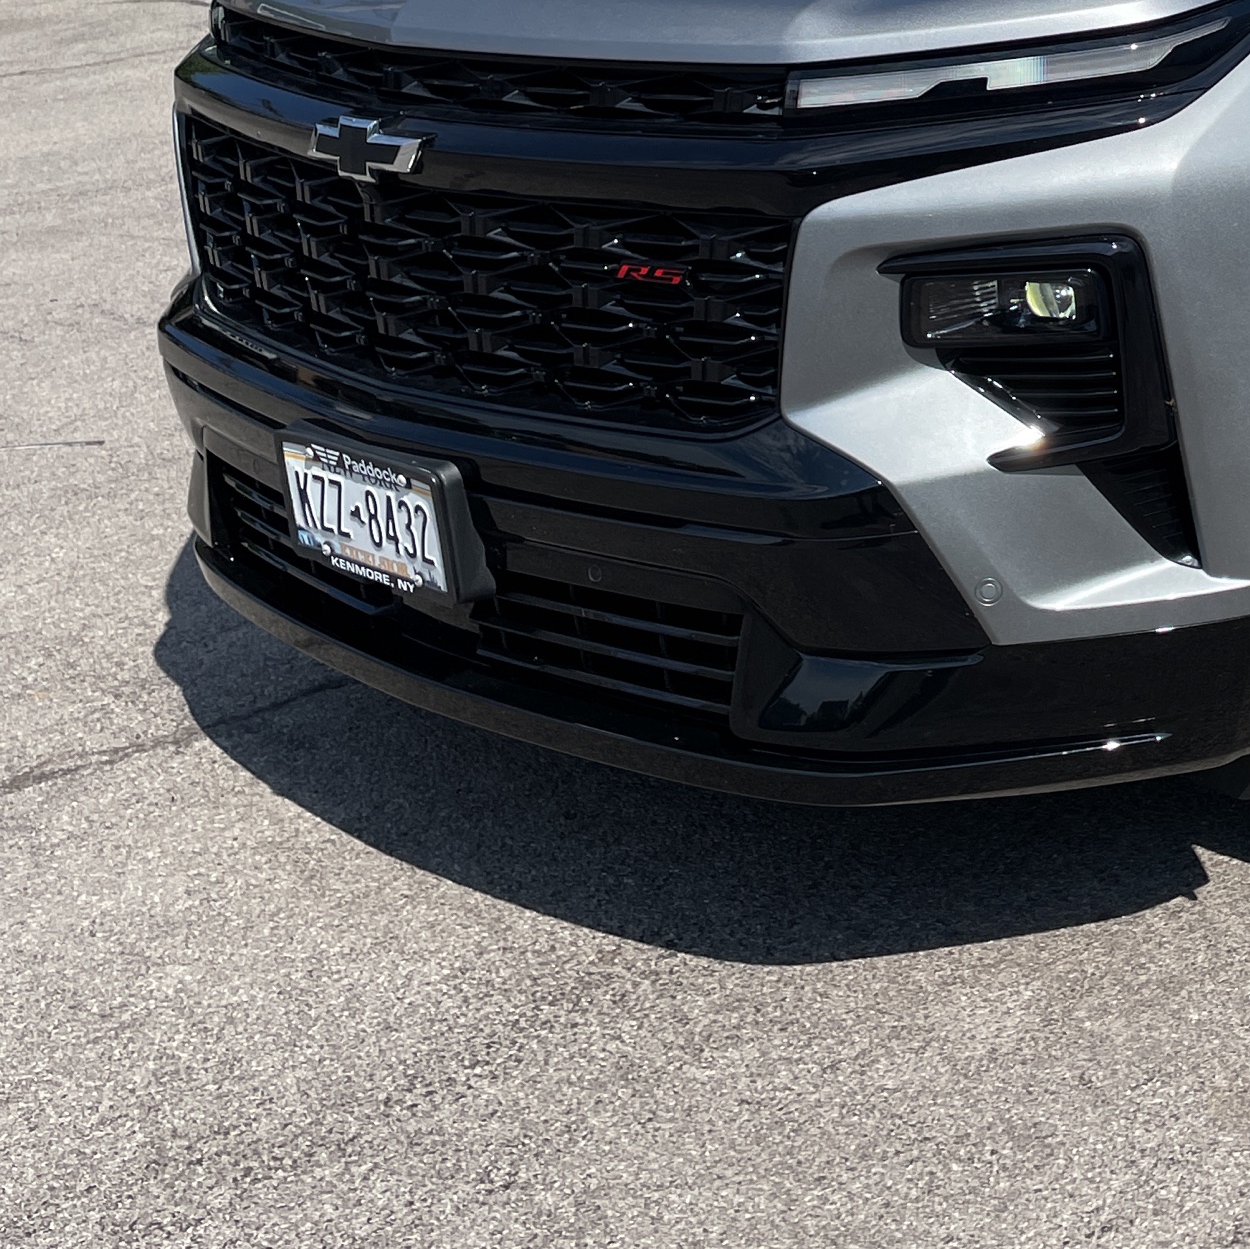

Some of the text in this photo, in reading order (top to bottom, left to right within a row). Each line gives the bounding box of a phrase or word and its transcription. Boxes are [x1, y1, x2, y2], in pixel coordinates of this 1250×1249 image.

[617, 264, 684, 285] RS
[341, 452, 400, 484] Paddock
[330, 555, 395, 588] KENMORE,
[397, 578, 416, 593] NY
